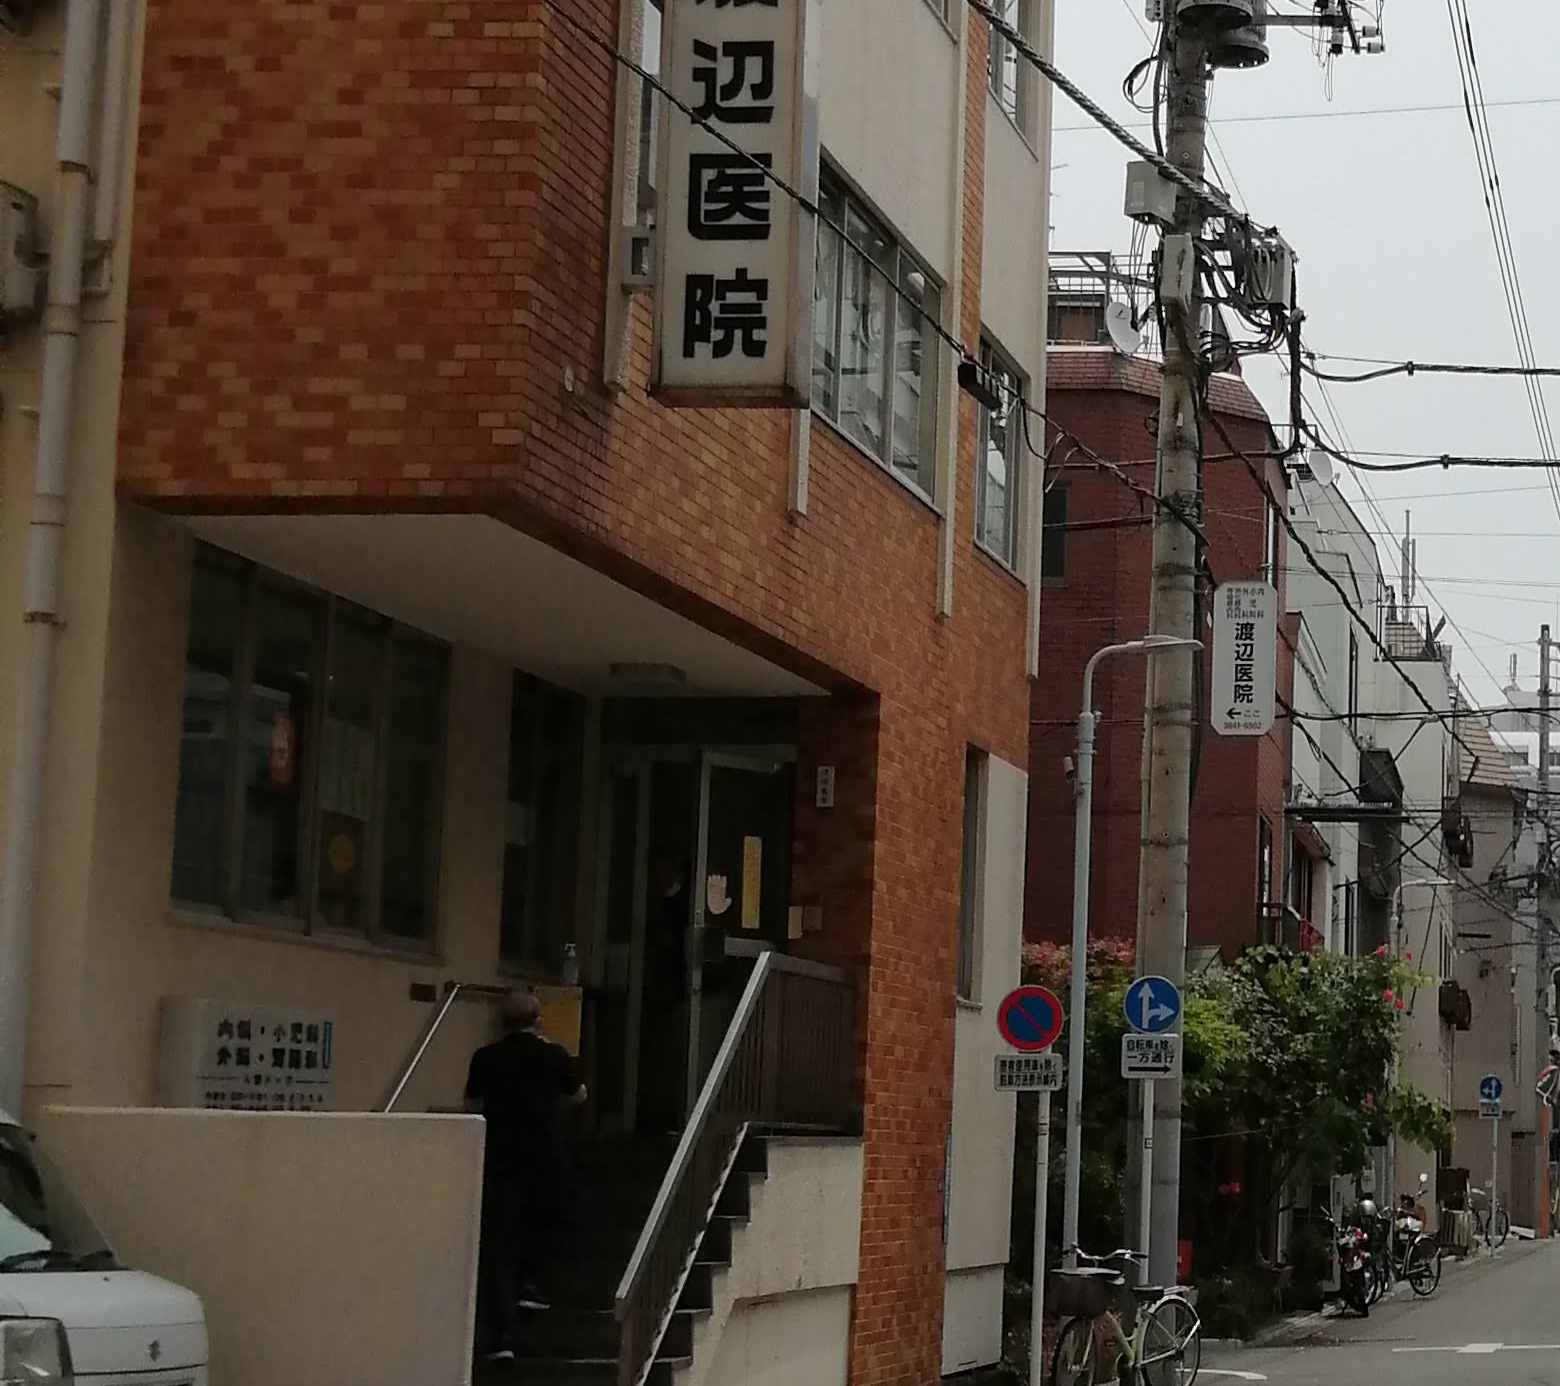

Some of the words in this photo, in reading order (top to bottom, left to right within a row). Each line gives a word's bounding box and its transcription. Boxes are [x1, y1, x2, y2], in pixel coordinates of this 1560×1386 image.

[1234, 622, 1255, 704] 渡辺医院
[1127, 1053, 1175, 1063] 一方通行
